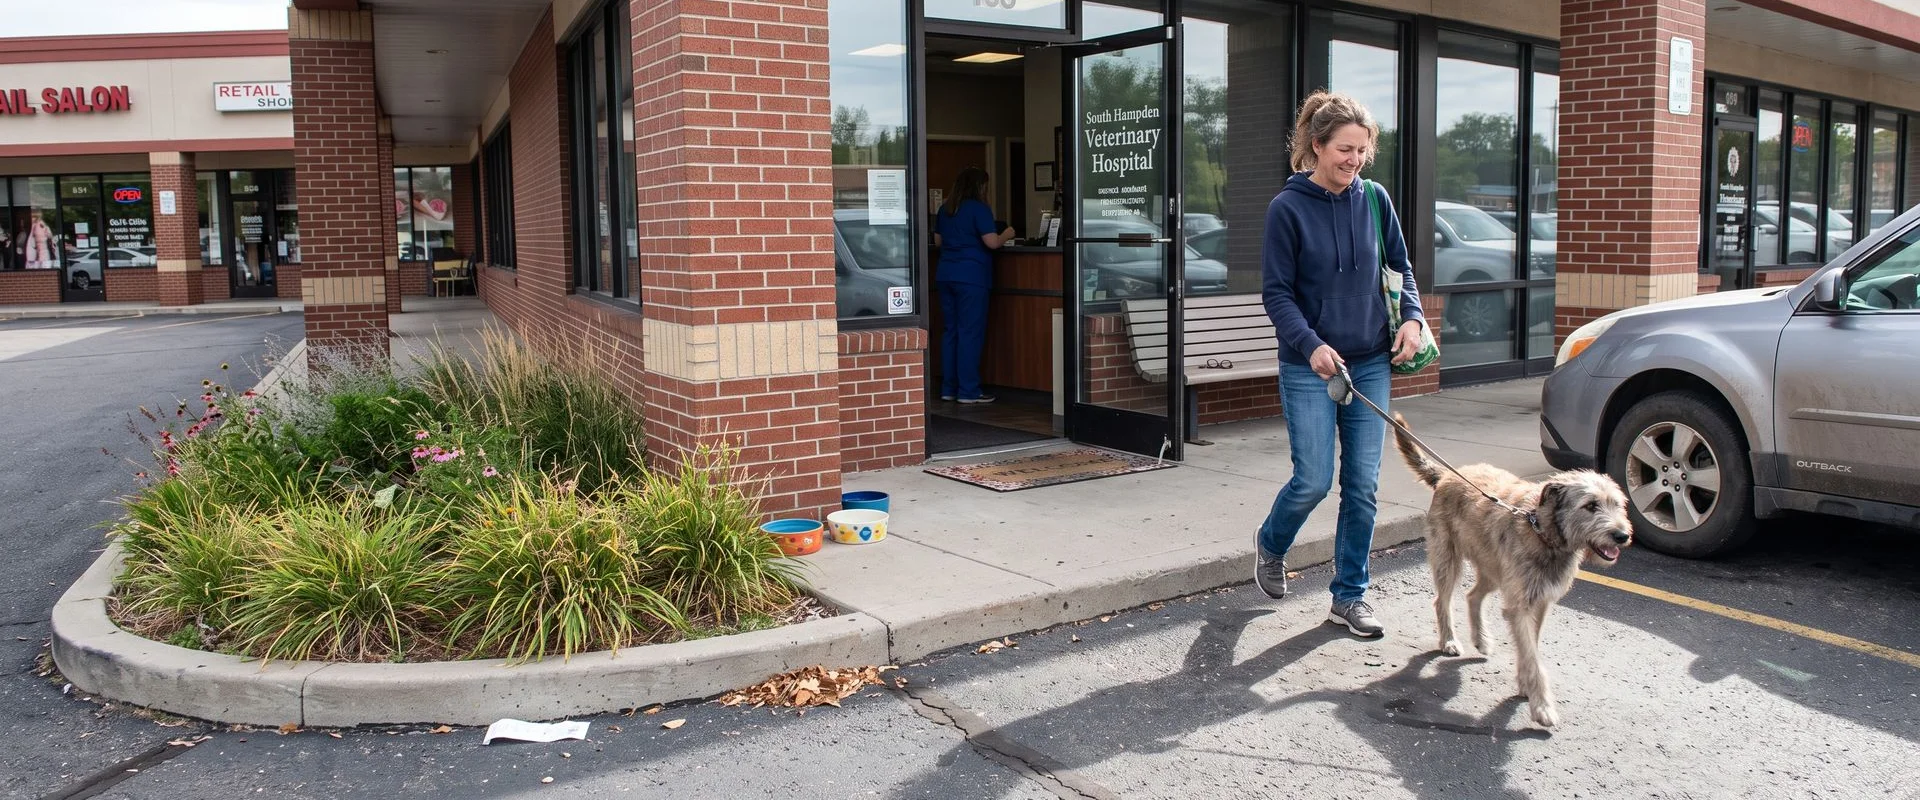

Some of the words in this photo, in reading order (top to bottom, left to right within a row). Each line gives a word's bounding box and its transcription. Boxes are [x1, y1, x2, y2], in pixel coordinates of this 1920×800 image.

[41, 85, 131, 114] SALON
[219, 85, 280, 97] RETAIL
[1086, 110, 1112, 124] South
[1114, 105, 1160, 123] Hampden
[1085, 126, 1161, 149] Veterinary
[1792, 125, 1813, 148] OPEN
[1092, 149, 1153, 177] Hospital
[113, 189, 142, 201] OPEN
[1796, 460, 1852, 473] OUTBACK
